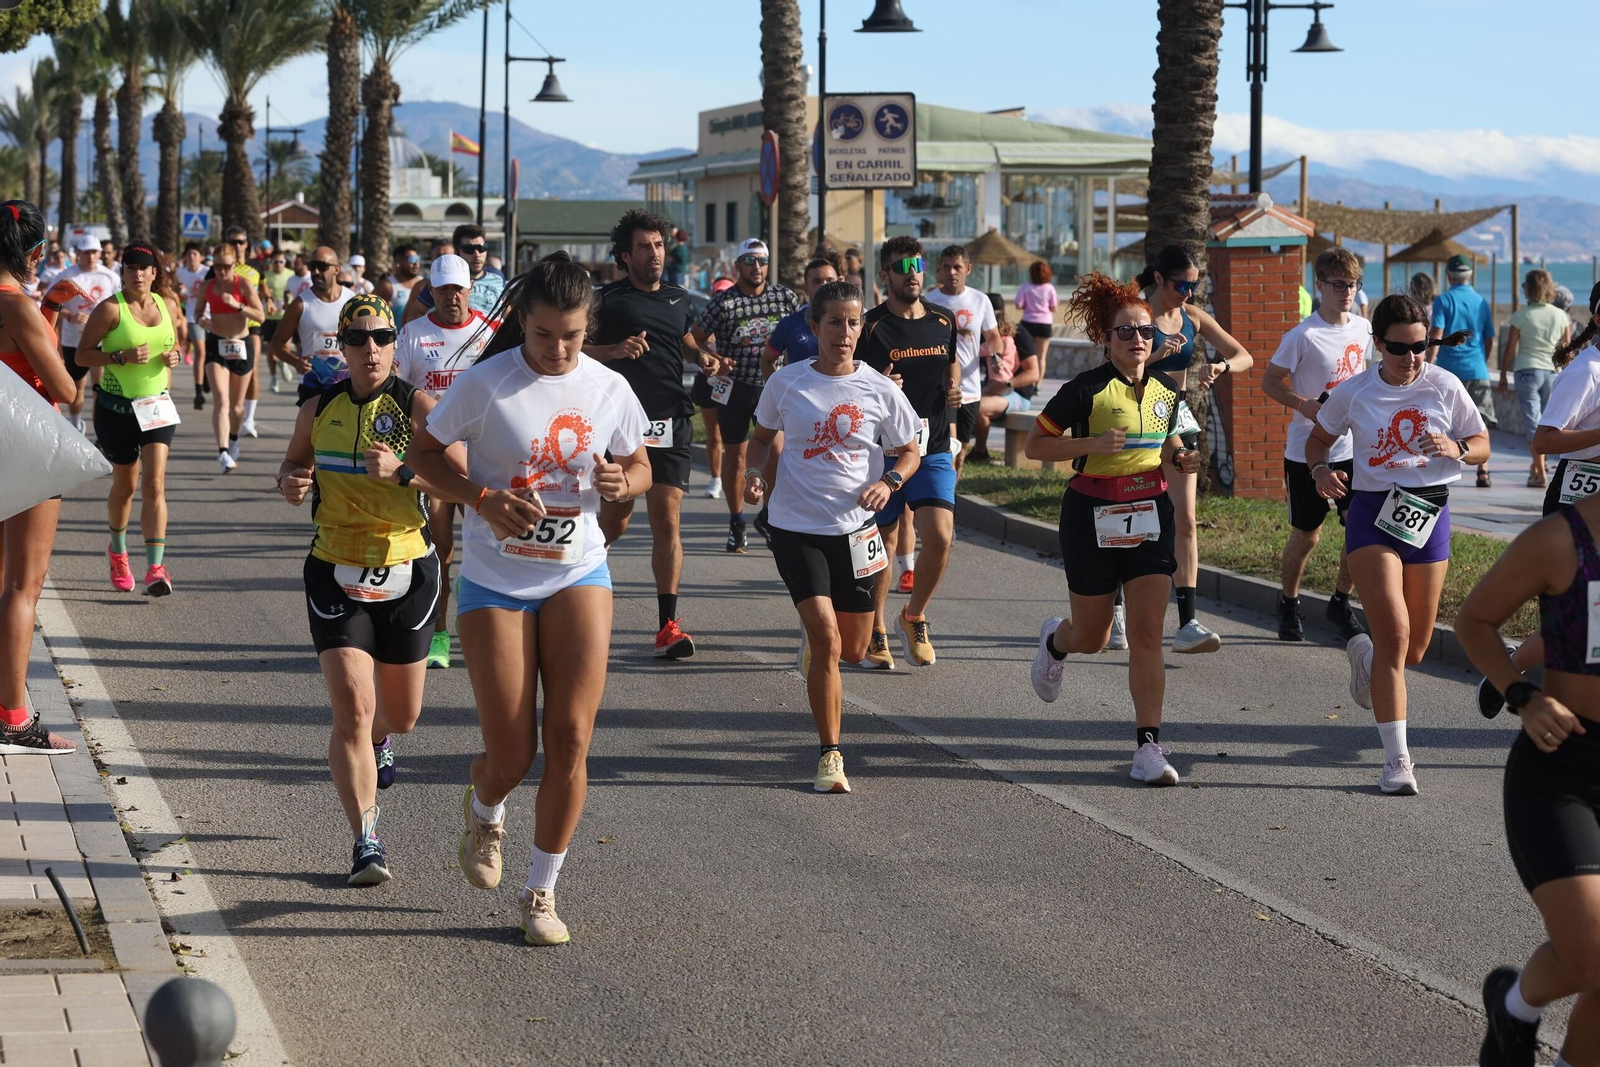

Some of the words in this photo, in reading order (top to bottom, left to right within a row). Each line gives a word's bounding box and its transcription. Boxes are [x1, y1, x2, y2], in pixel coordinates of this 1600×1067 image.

[828, 147, 867, 155] BICICLETAS
[878, 147, 906, 155] PATINES
[836, 160, 853, 170] EN
[857, 159, 904, 170] CARRIL
[829, 172, 911, 183] SEÑALIZADO
[889, 345, 943, 361] Continental
[153, 404, 160, 417] 4
[1123, 515, 1133, 534] 1
[1391, 505, 1431, 533] 681
[506, 546, 519, 554] 024
[867, 536, 883, 561] 94
